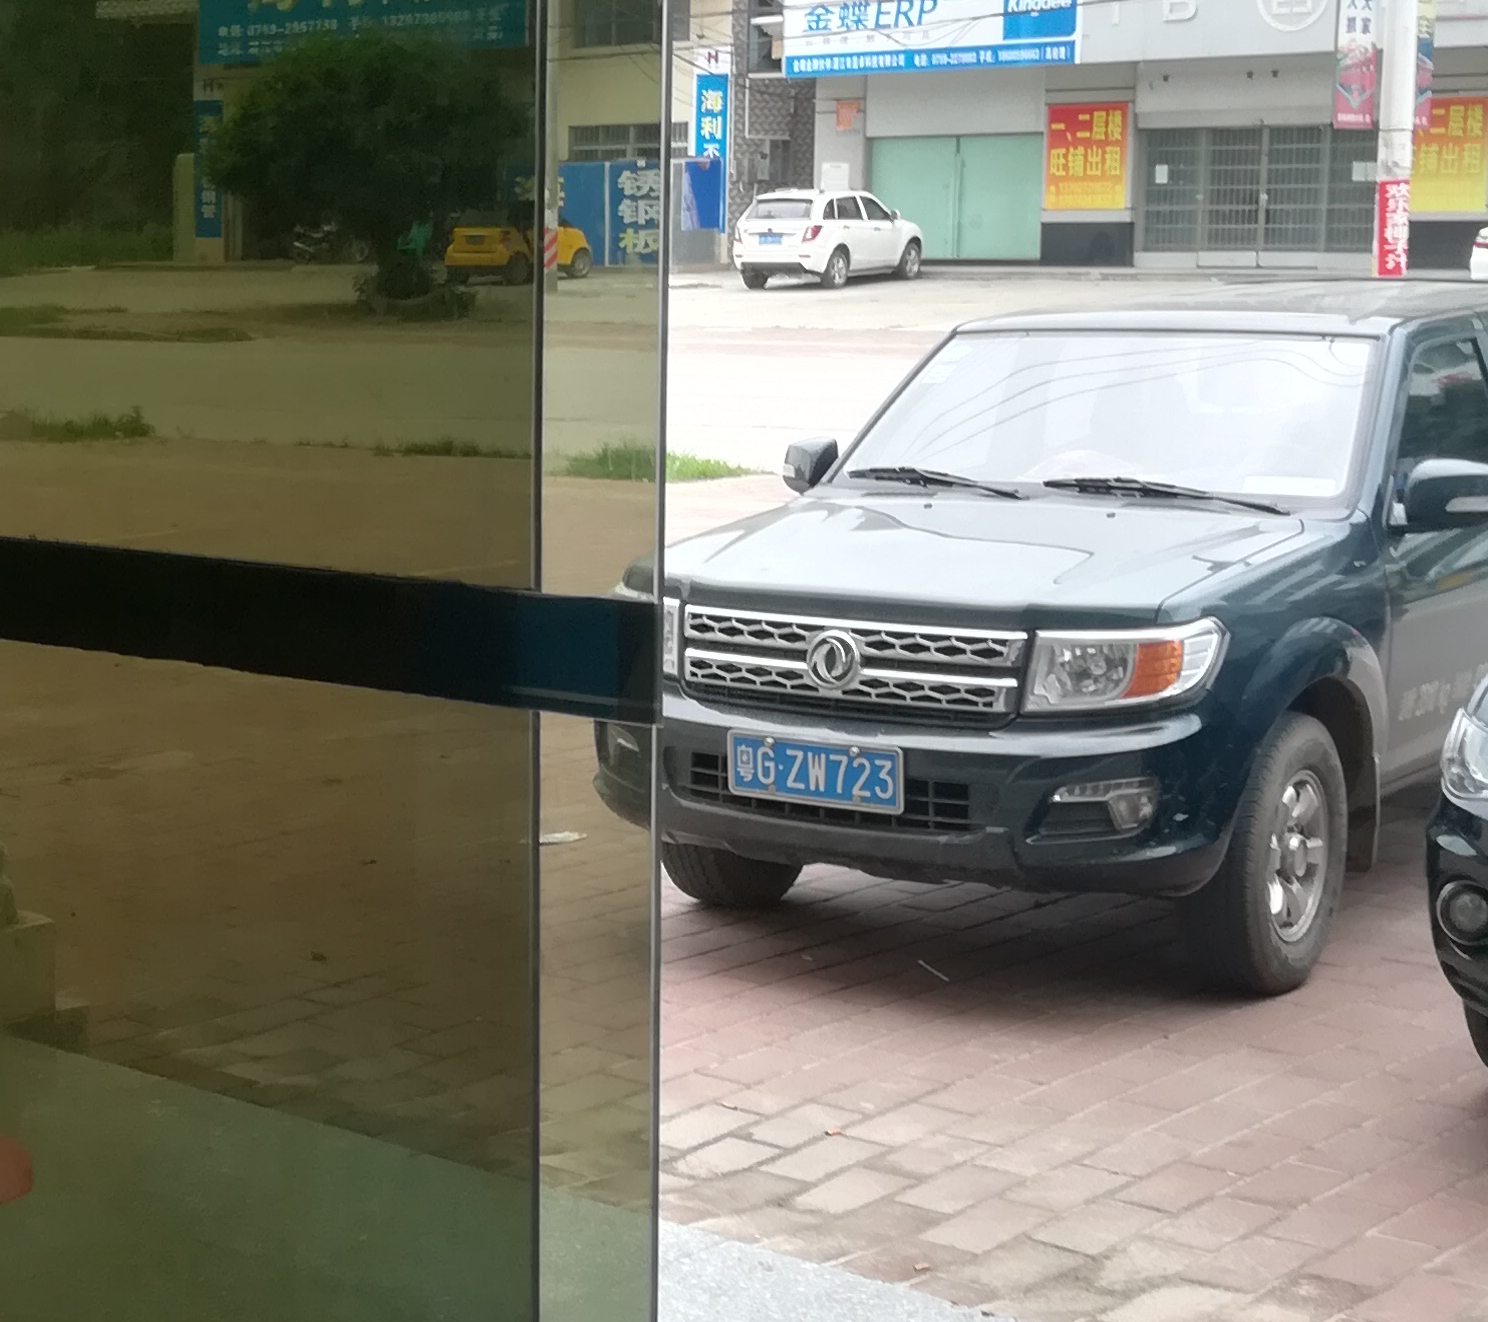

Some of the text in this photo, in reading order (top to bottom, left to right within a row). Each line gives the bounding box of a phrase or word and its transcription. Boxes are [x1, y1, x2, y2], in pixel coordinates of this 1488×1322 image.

[1050, 109, 1123, 141] 一、二层楼
[1049, 145, 1122, 177] 旺铺出租
[1413, 142, 1483, 175] 铺出租
